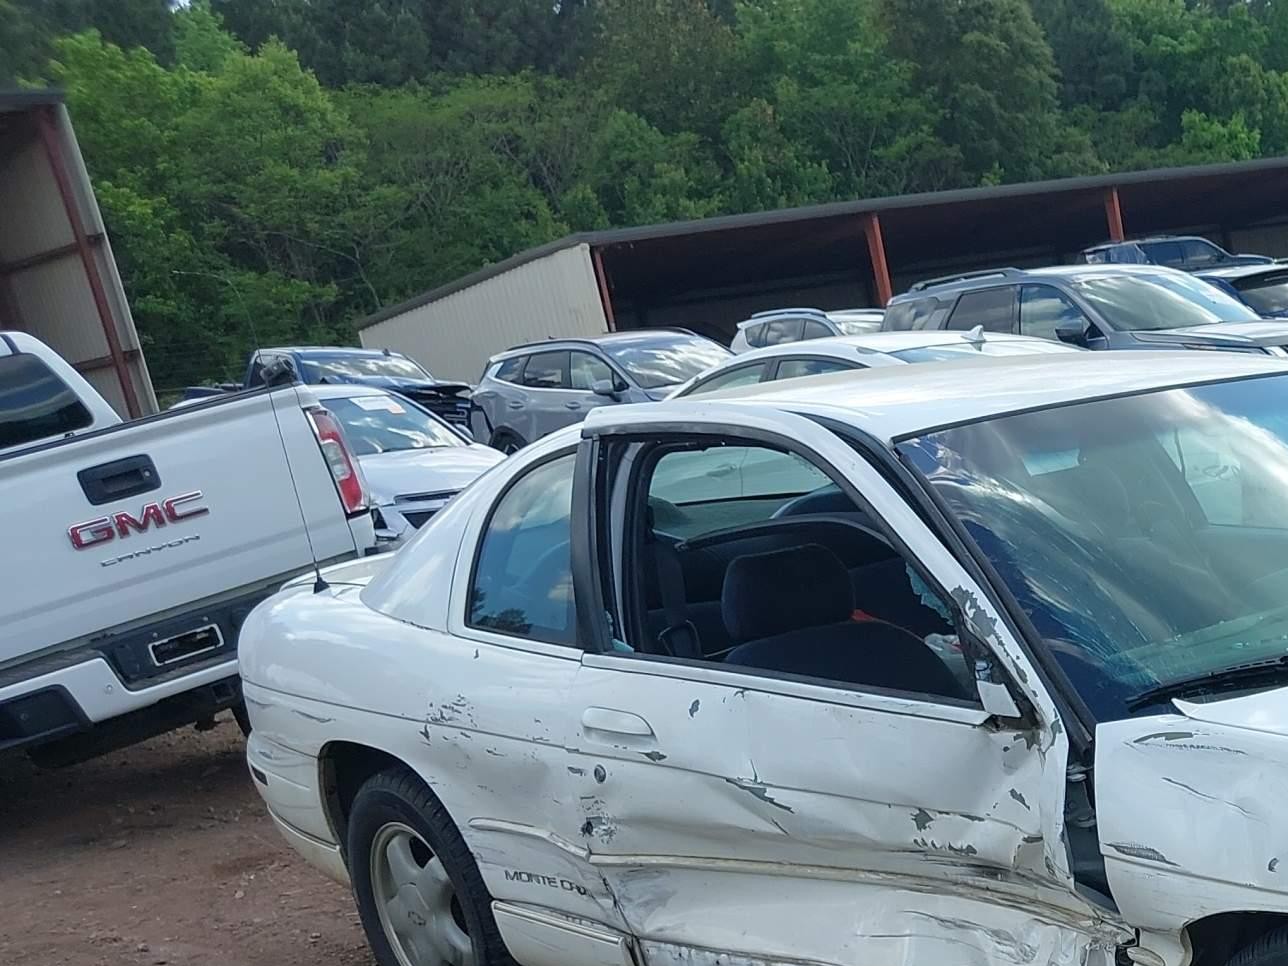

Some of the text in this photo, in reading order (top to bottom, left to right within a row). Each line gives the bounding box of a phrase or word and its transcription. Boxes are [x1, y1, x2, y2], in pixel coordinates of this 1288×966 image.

[68, 490, 209, 551] GMC
[100, 534, 200, 567] CANYON
[504, 869, 558, 888] MONTE
